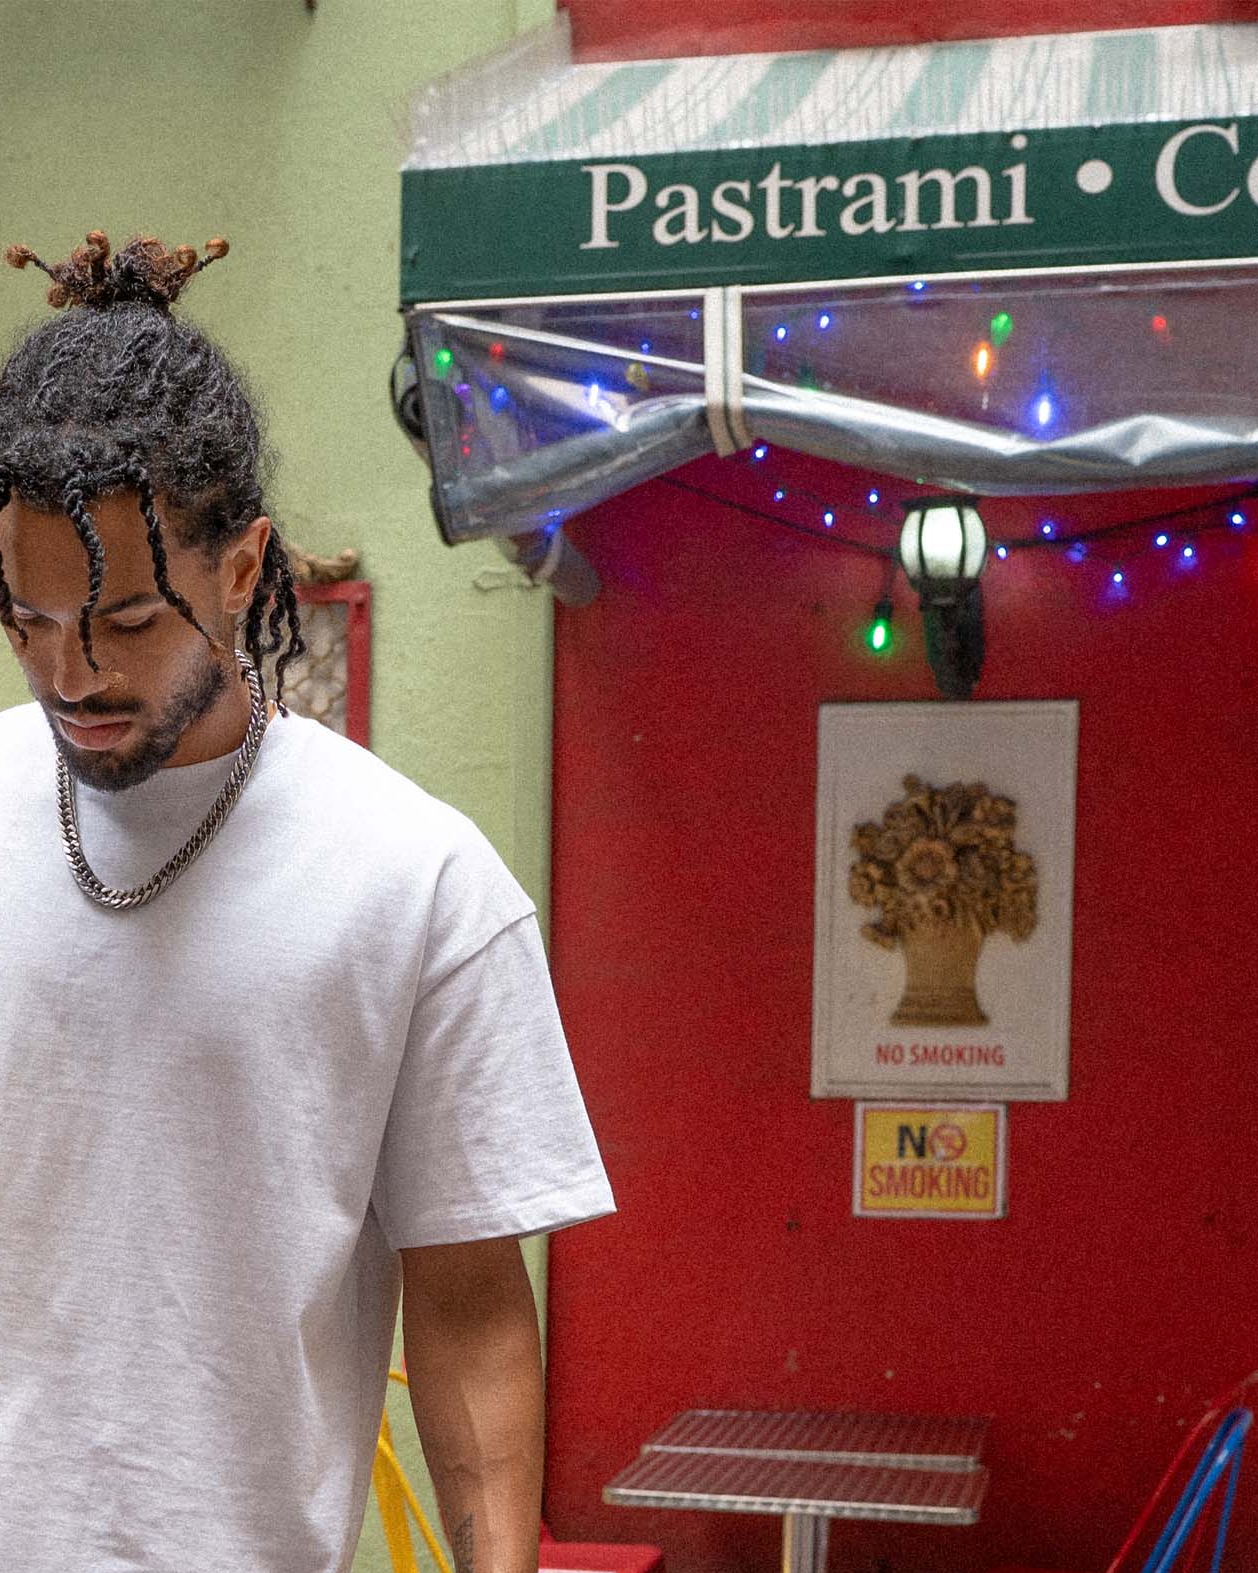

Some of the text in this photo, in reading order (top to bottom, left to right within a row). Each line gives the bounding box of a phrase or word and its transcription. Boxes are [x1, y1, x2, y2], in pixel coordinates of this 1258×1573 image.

[579, 122, 1258, 251] Pastrami C
[875, 1043, 1006, 1067] NO SMOKING
[869, 1164, 990, 1199] SMOKING
